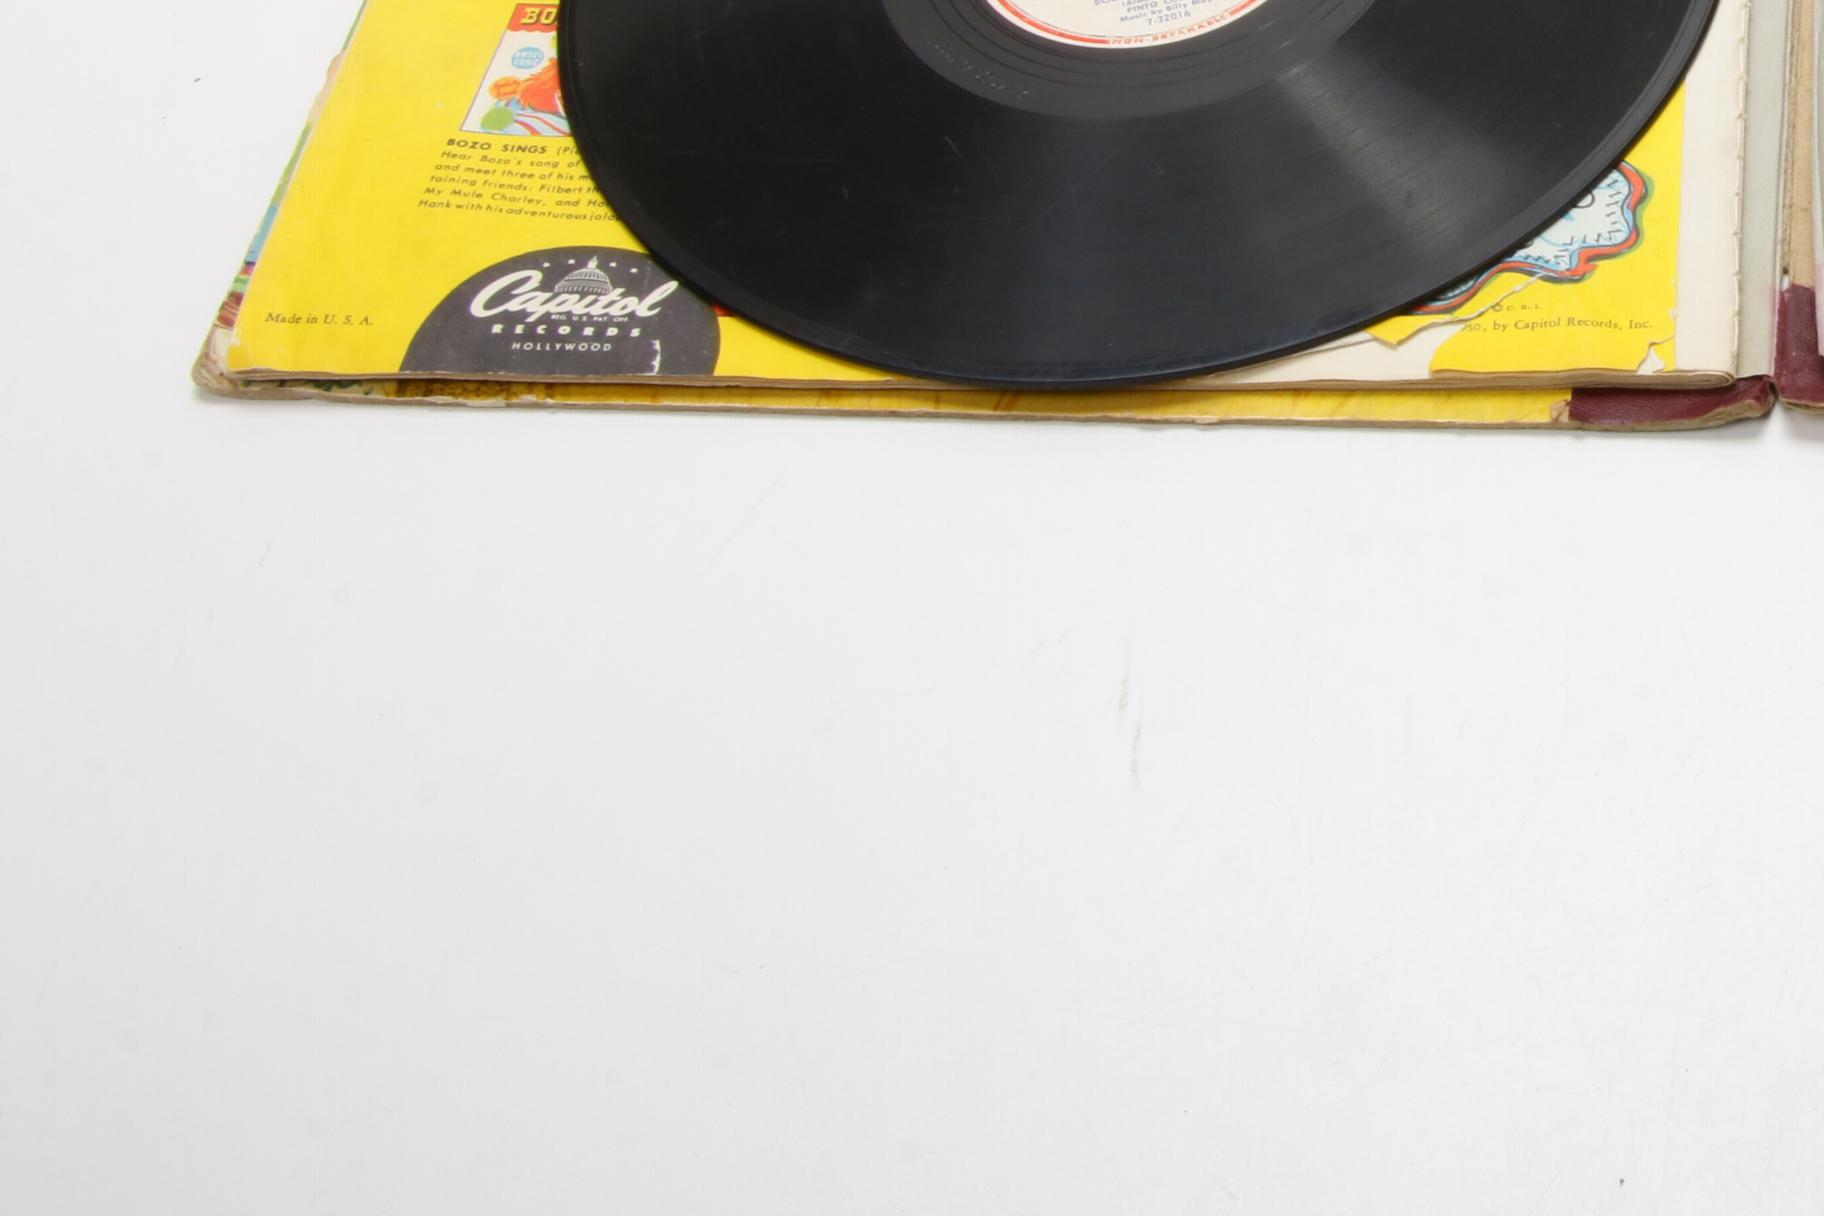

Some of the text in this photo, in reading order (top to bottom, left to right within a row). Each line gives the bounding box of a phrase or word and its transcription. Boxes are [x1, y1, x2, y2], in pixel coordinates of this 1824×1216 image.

[1120, 10, 1148, 24] Music
[1150, 7, 1163, 18] by
[1165, 1, 1188, 14] Billy
[1127, 1, 1159, 14] PINTO
[1147, 9, 1192, 26] 7-32016
[446, 137, 492, 151] BOZO
[501, 143, 548, 155] SINGS
[440, 150, 472, 161] Hear
[530, 160, 561, 170] song
[434, 163, 460, 172] and
[463, 166, 497, 176] meet
[501, 168, 536, 180] three
[538, 171, 554, 181] of
[557, 171, 574, 182] his
[430, 174, 478, 188] taining
[538, 183, 583, 195] Filbert
[423, 186, 442, 196] My
[450, 188, 483, 199] Mule
[555, 197, 580, 208] and
[417, 197, 452, 209] Hank
[455, 201, 482, 212] with
[484, 202, 504, 214] his
[505, 205, 589, 221] adventurous
[470, 270, 679, 323] Capitol
[264, 312, 303, 325] Made
[305, 313, 319, 325] in
[1492, 320, 1509, 333] by
[1513, 317, 1561, 332] Capitol
[1566, 316, 1623, 331] Records,
[1628, 319, 1653, 330] Inc.
[491, 324, 641, 338] RECORDS
[511, 342, 613, 353] HOLLYWOOD
